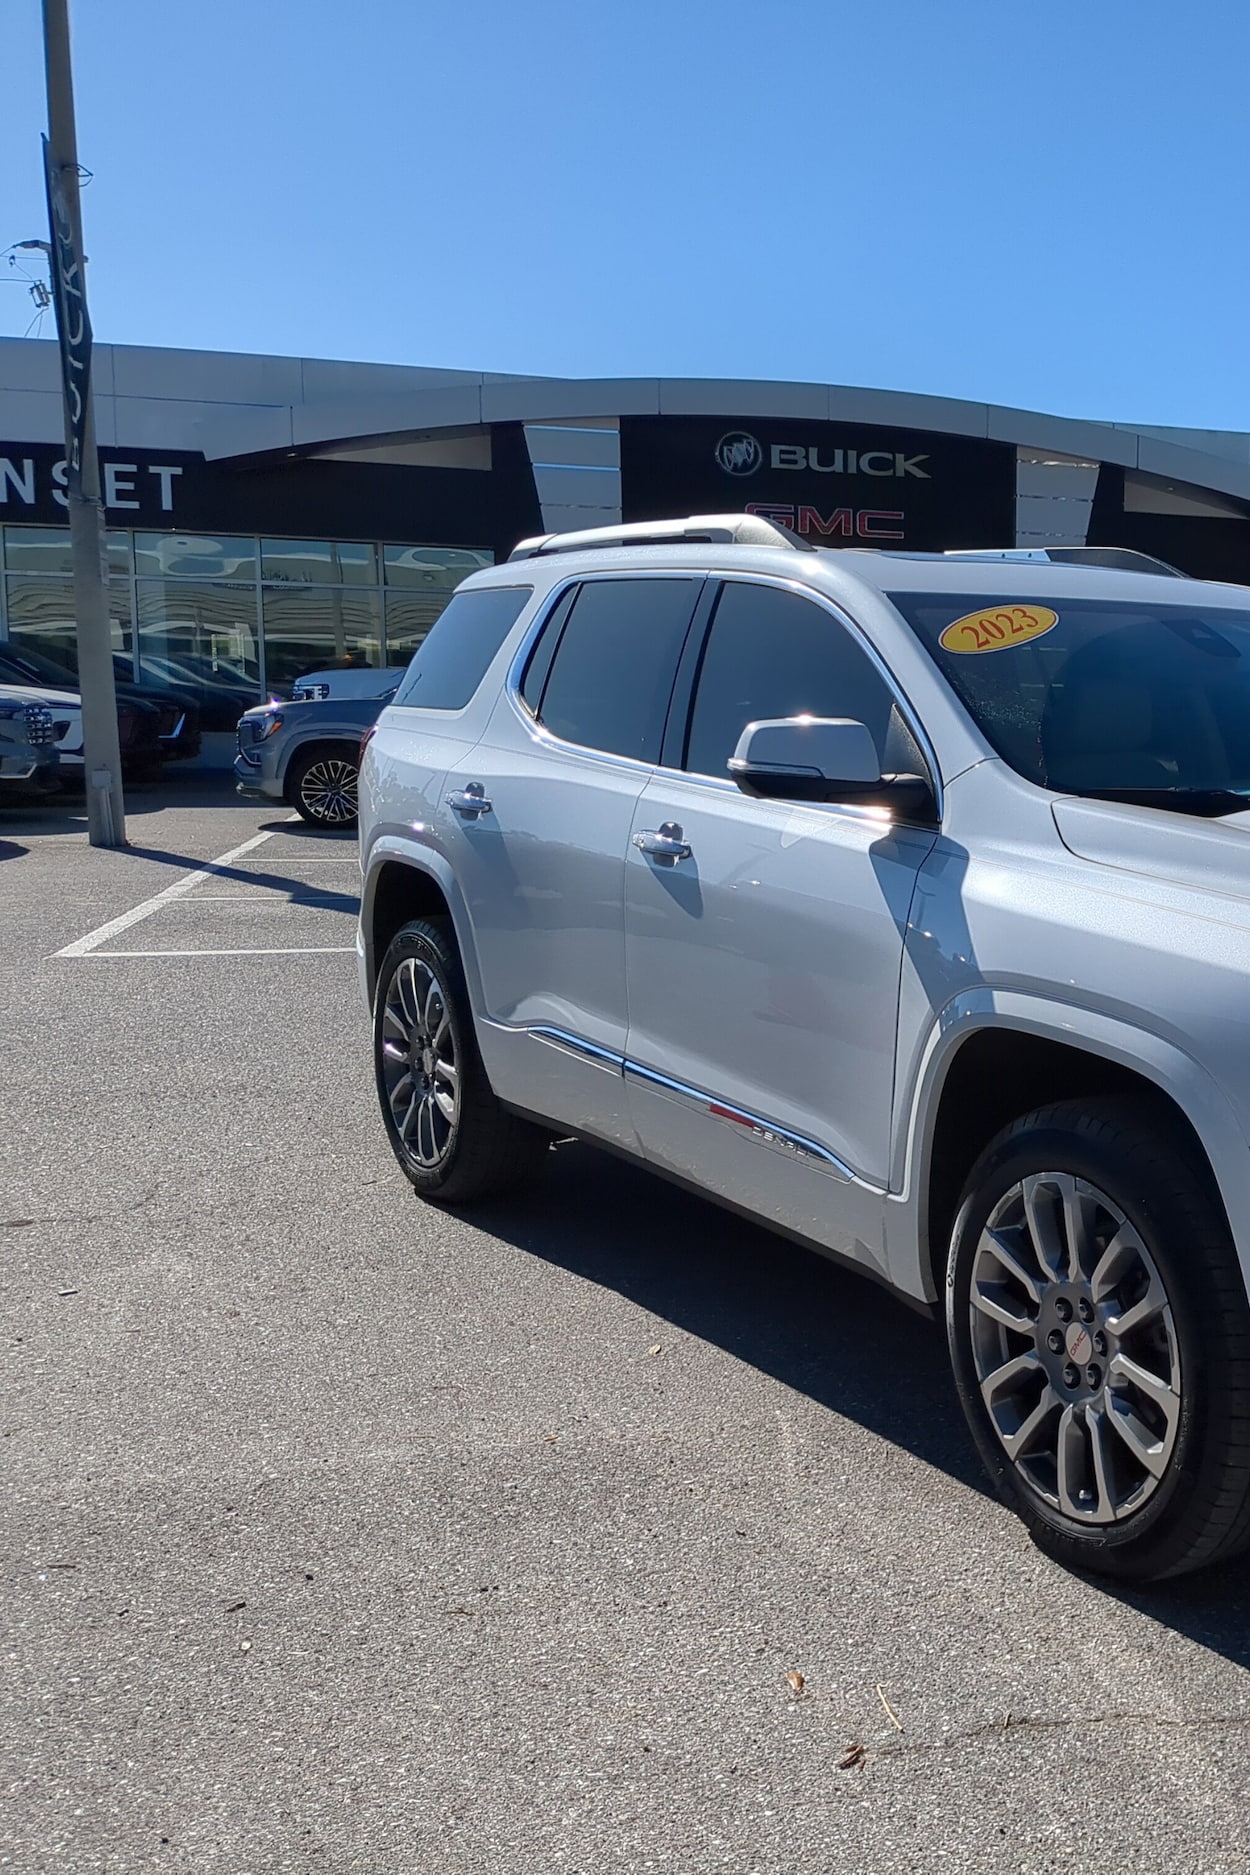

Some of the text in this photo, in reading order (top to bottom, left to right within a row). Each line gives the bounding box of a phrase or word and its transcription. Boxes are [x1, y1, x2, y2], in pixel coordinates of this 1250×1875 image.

[770, 444, 932, 479] BUICK
[960, 608, 1039, 649] 2023
[1071, 1331, 1087, 1356] GMC
